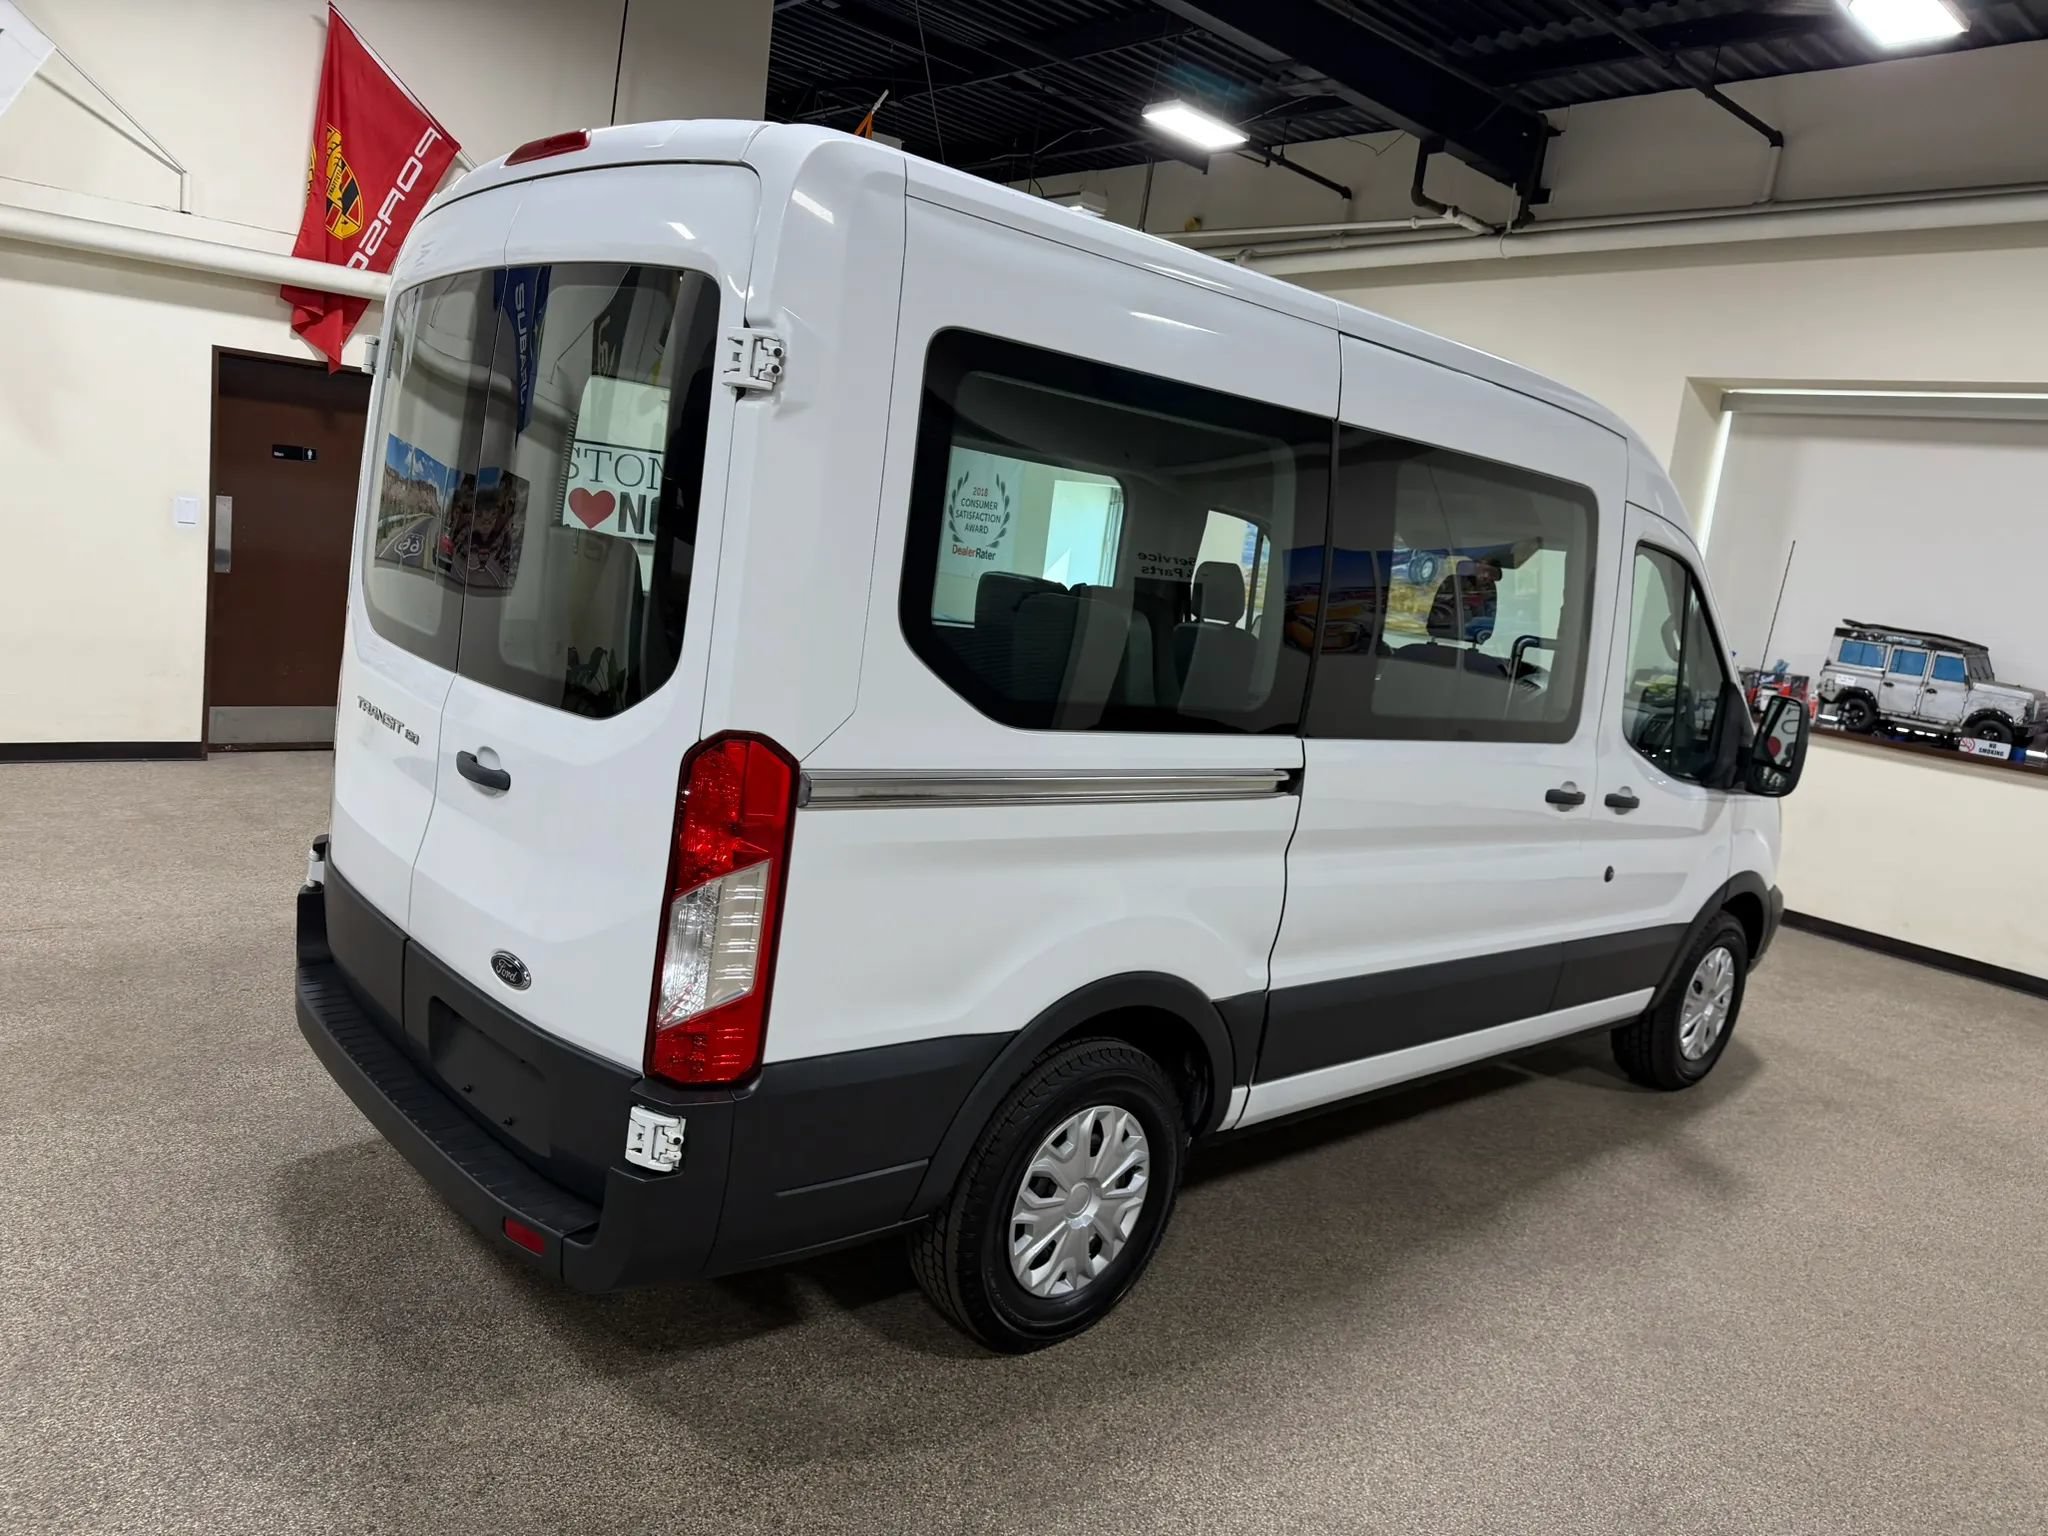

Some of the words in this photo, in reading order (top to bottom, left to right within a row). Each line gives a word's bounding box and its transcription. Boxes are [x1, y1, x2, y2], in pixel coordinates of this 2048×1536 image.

[972, 487, 989, 497] 2018
[960, 498, 998, 511] CONSUMER
[955, 509, 1002, 523] SATISFACTION
[964, 523, 989, 535] AWARD
[357, 695, 405, 734] TRANSIT
[1978, 748, 2004, 756] SMOKING
[495, 958, 518, 982] Ford
